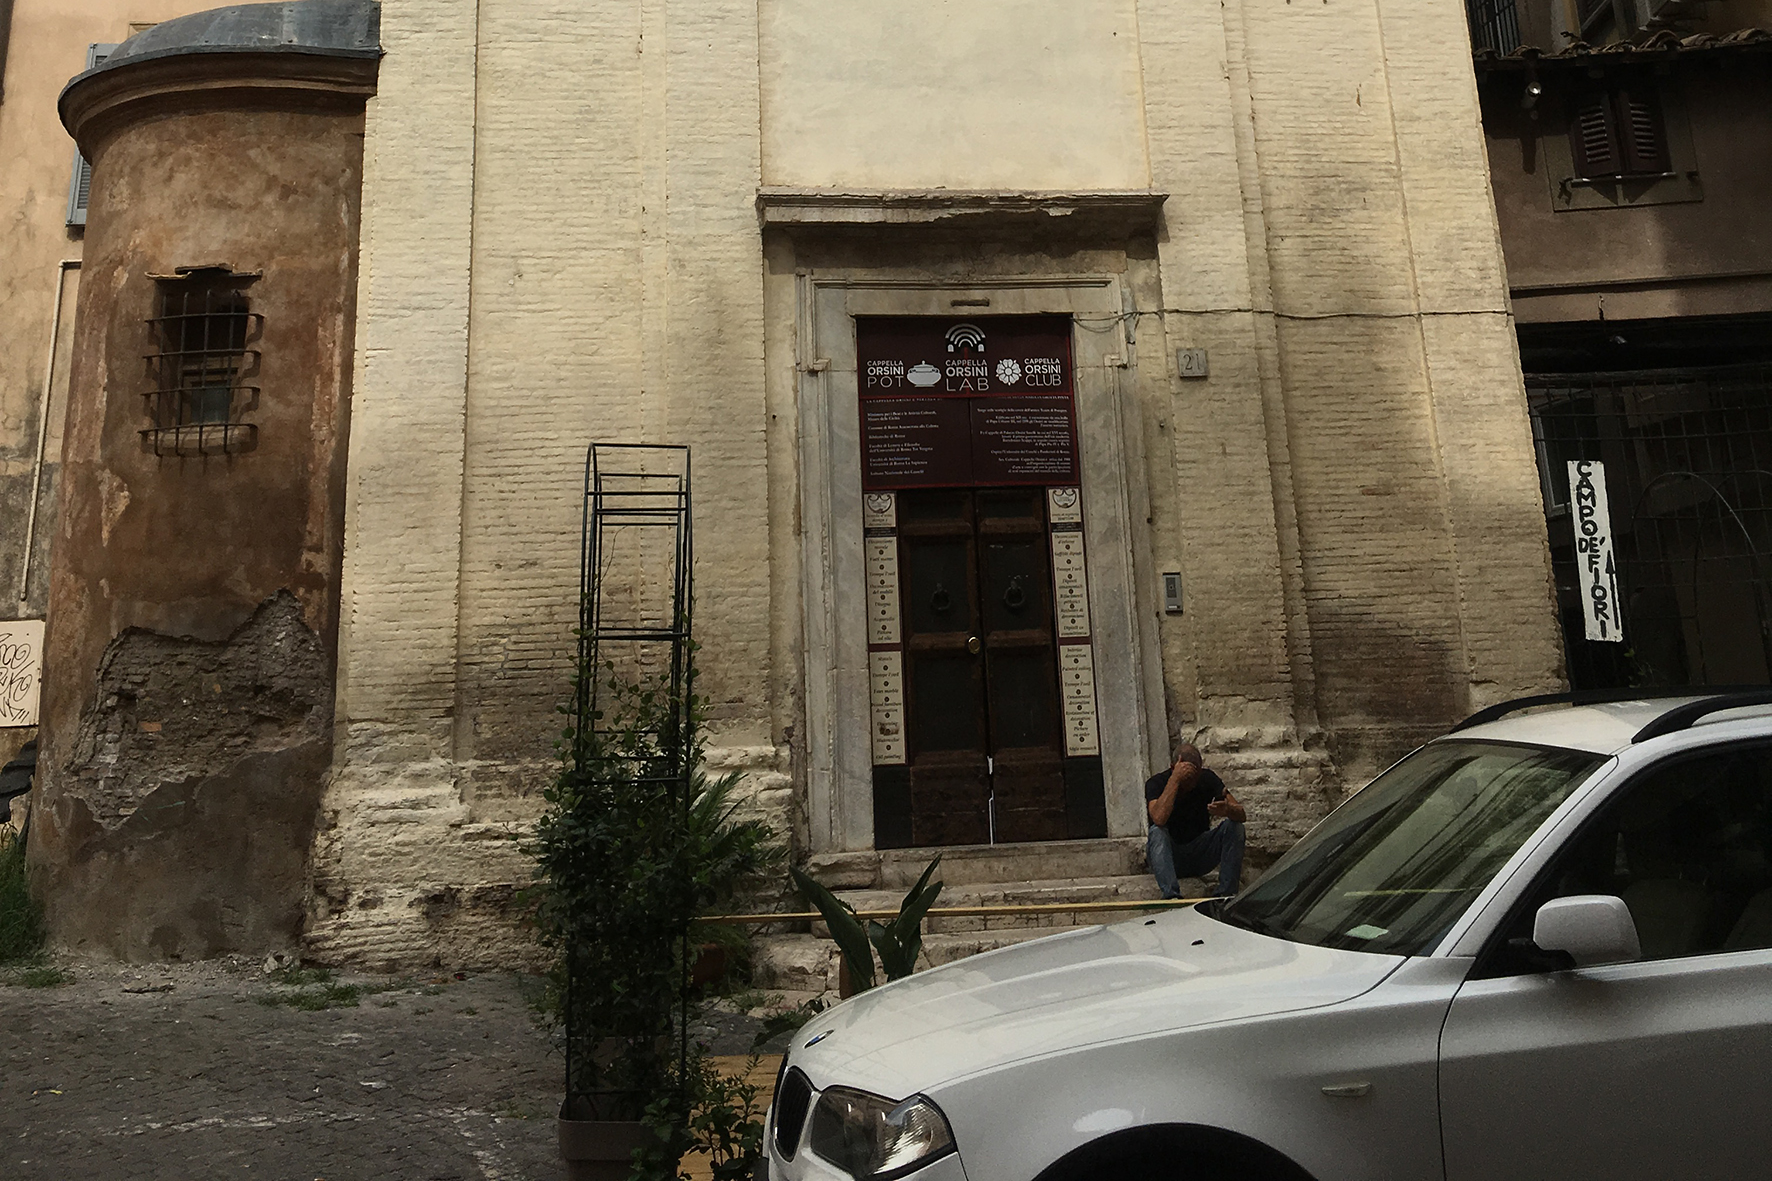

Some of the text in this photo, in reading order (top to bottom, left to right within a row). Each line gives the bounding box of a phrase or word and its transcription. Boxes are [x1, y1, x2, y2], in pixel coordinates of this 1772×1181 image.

[1183, 353, 1200, 370] 21
[867, 366, 904, 376] ORSINI
[945, 366, 988, 377] ORSINI
[1024, 364, 1061, 374] ORSINI
[867, 375, 904, 389] POT
[946, 377, 990, 392] LAB
[1025, 374, 1062, 387] CLUB
[1576, 460, 1599, 536] CAMPO
[1587, 554, 1610, 639] FIORI
